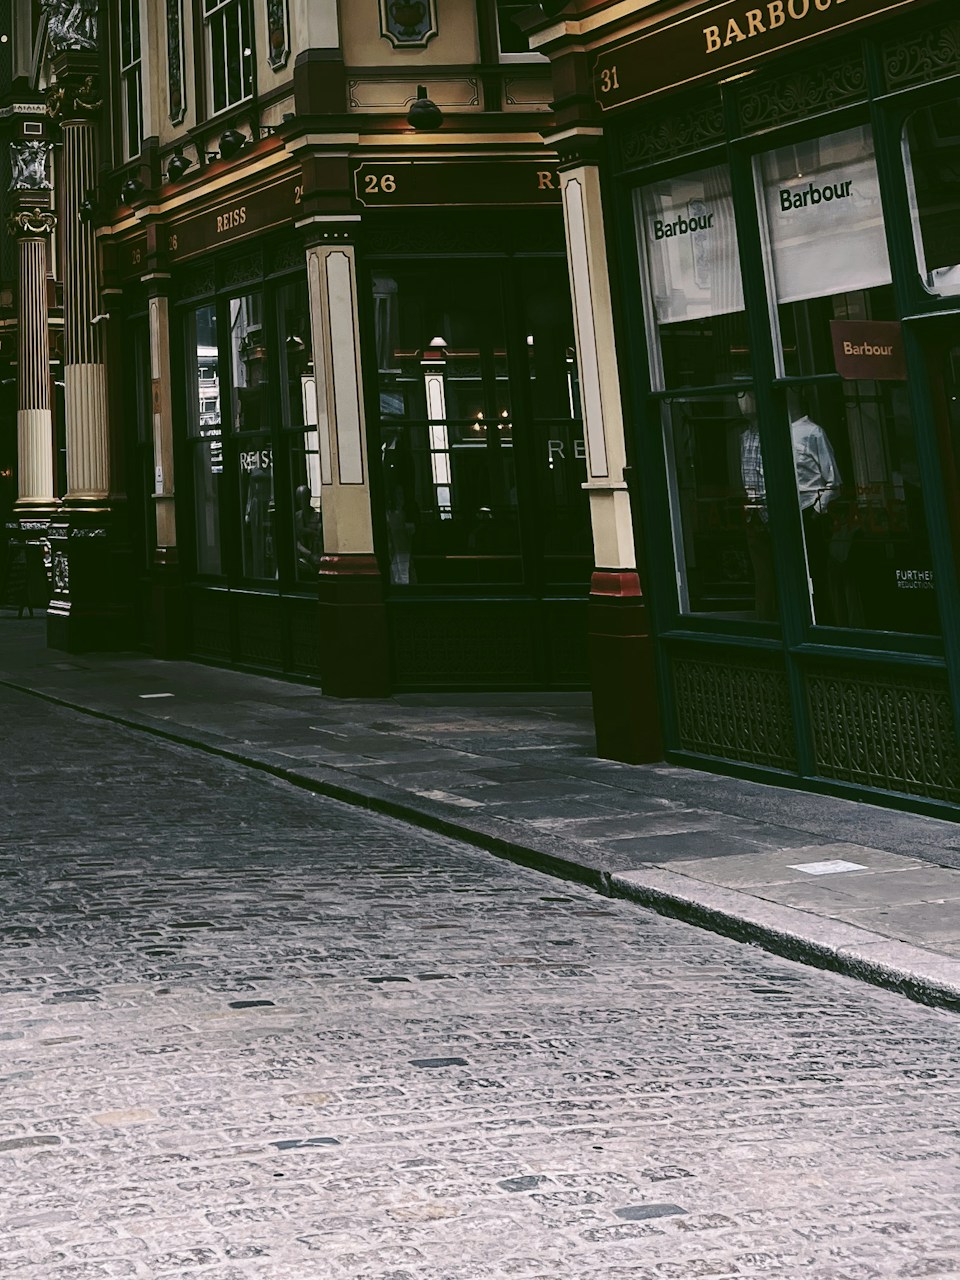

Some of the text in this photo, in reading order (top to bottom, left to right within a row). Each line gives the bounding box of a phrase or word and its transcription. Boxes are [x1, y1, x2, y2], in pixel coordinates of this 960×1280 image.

[601, 65, 620, 92] 31
[365, 171, 561, 193] 26 R
[217, 207, 246, 233] REISS
[843, 341, 893, 355] Barbour
